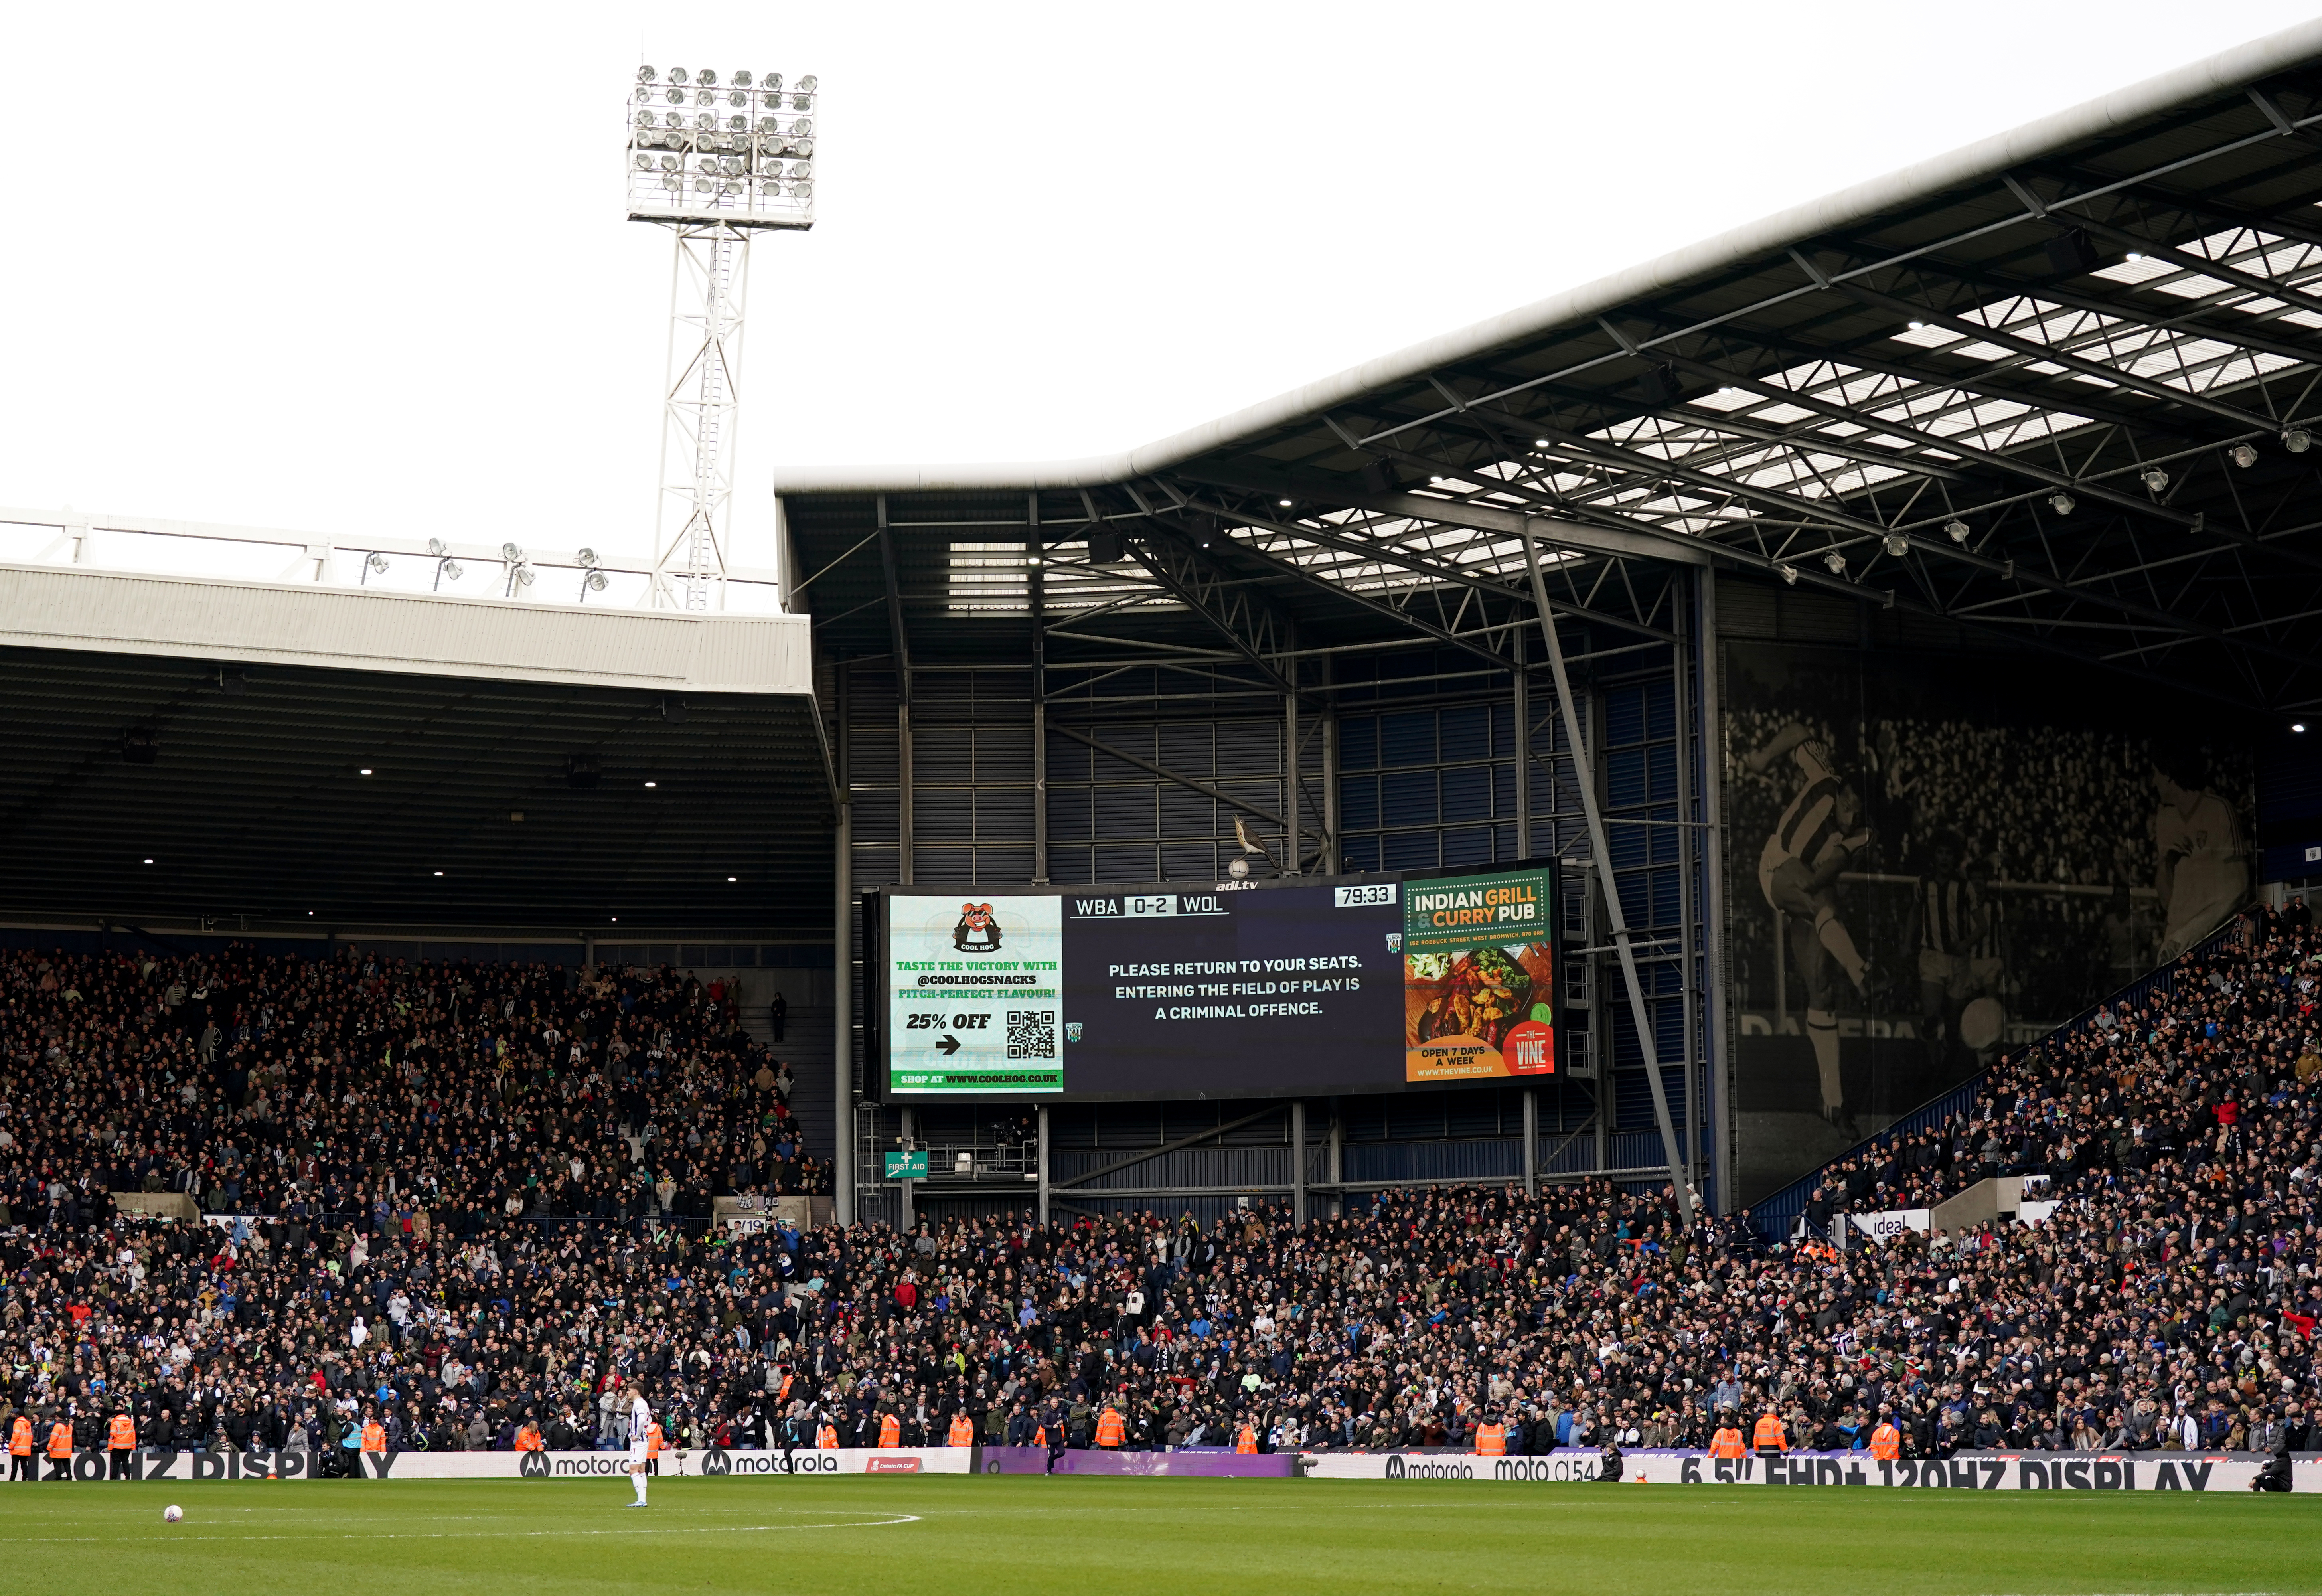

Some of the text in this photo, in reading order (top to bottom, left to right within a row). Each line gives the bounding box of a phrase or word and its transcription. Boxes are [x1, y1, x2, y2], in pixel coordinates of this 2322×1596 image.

[1216, 881, 1258, 891] adi.tv
[1076, 896, 1223, 915] WBA 0-2 WOL
[1342, 887, 1389, 905] 79:33
[1415, 886, 1537, 911] INDIAN GRILL
[1418, 903, 1535, 928] & CURRY PUB
[896, 961, 1057, 971] TASTE THE VICTORY WITH
[1109, 955, 1362, 977] PLEASE RETURN TO YOUR SEATS.
[917, 975, 1036, 987] @COOLHOGSNACKS
[1115, 977, 1360, 999] ENTERING THE FIELD OF PLAY IS
[898, 989, 1056, 998] PITCH-PERFECT FLAVOUR!
[1155, 1001, 1323, 1020] A CRIMINAL OFFENCE.
[906, 1013, 991, 1029] 25% OFF
[1526, 1030, 1536, 1039] THE
[1422, 1046, 1485, 1058] OPEN 7 DAYS
[1436, 1056, 1475, 1066] A WEEK
[1516, 1040, 1546, 1065] VINE
[901, 1075, 928, 1083] SHOP
[946, 1075, 1058, 1083] WWW.COOLHOG.CO.UK
[1417, 1066, 1493, 1077] WWW.THEVINE.CO.UK
[1874, 1215, 1905, 1235] ideal
[192, 1452, 398, 1479] DISPY
[556, 1455, 652, 1474] motoro
[736, 1453, 837, 1472] motorola
[1408, 1460, 1473, 1479] motorola
[1495, 1456, 1549, 1481] moto
